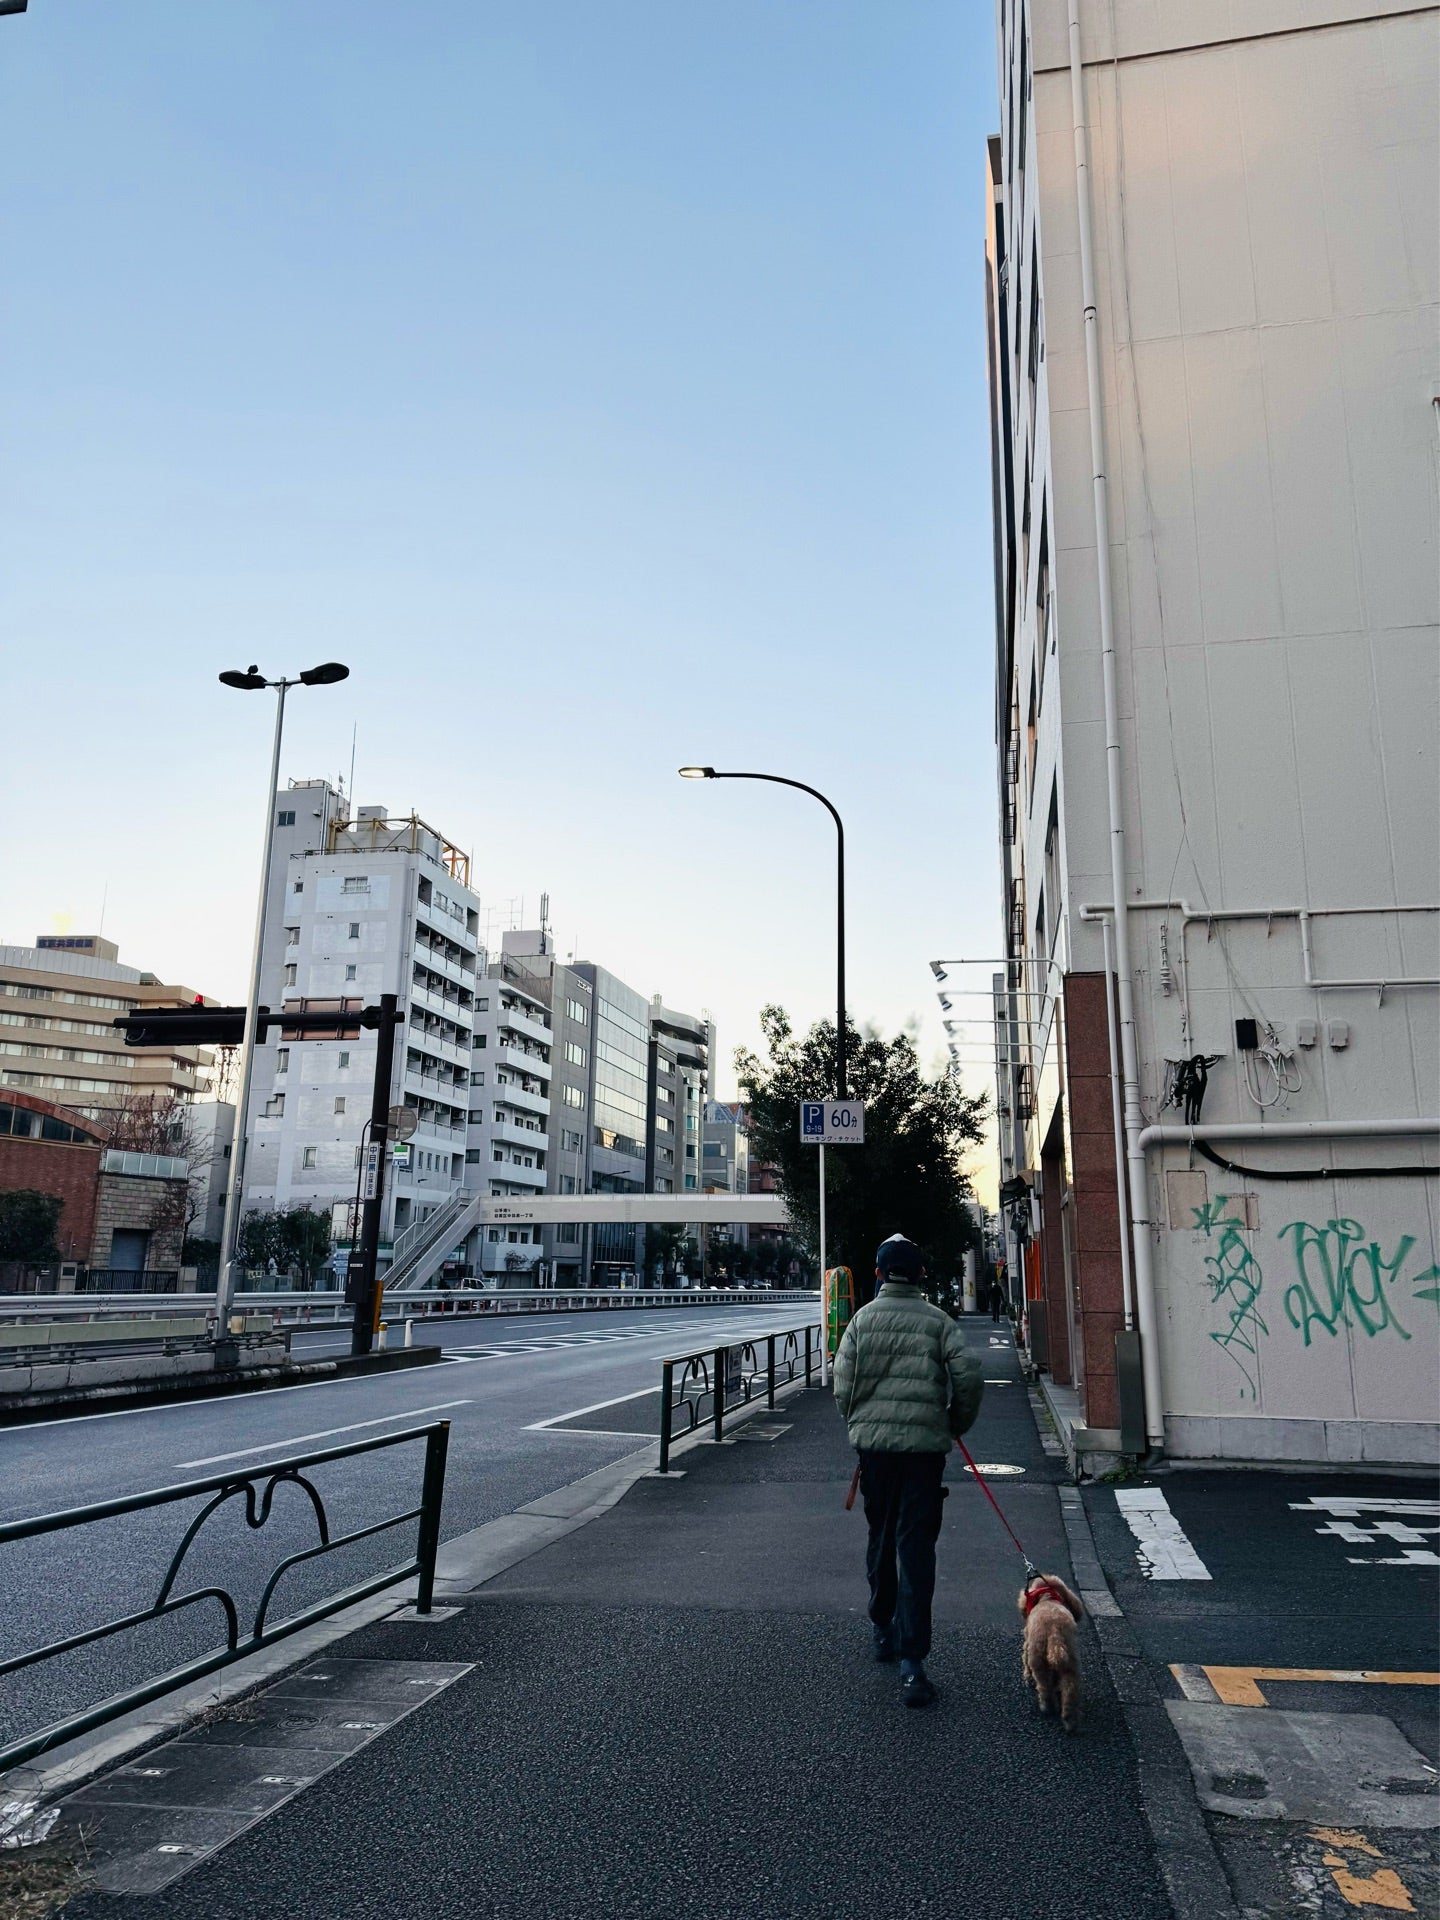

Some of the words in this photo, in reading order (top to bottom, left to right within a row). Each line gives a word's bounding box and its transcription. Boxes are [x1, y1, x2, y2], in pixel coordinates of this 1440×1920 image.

[809, 1106, 820, 1124] P
[831, 1109, 857, 1128] 60分
[806, 1125, 822, 1133] 9-19
